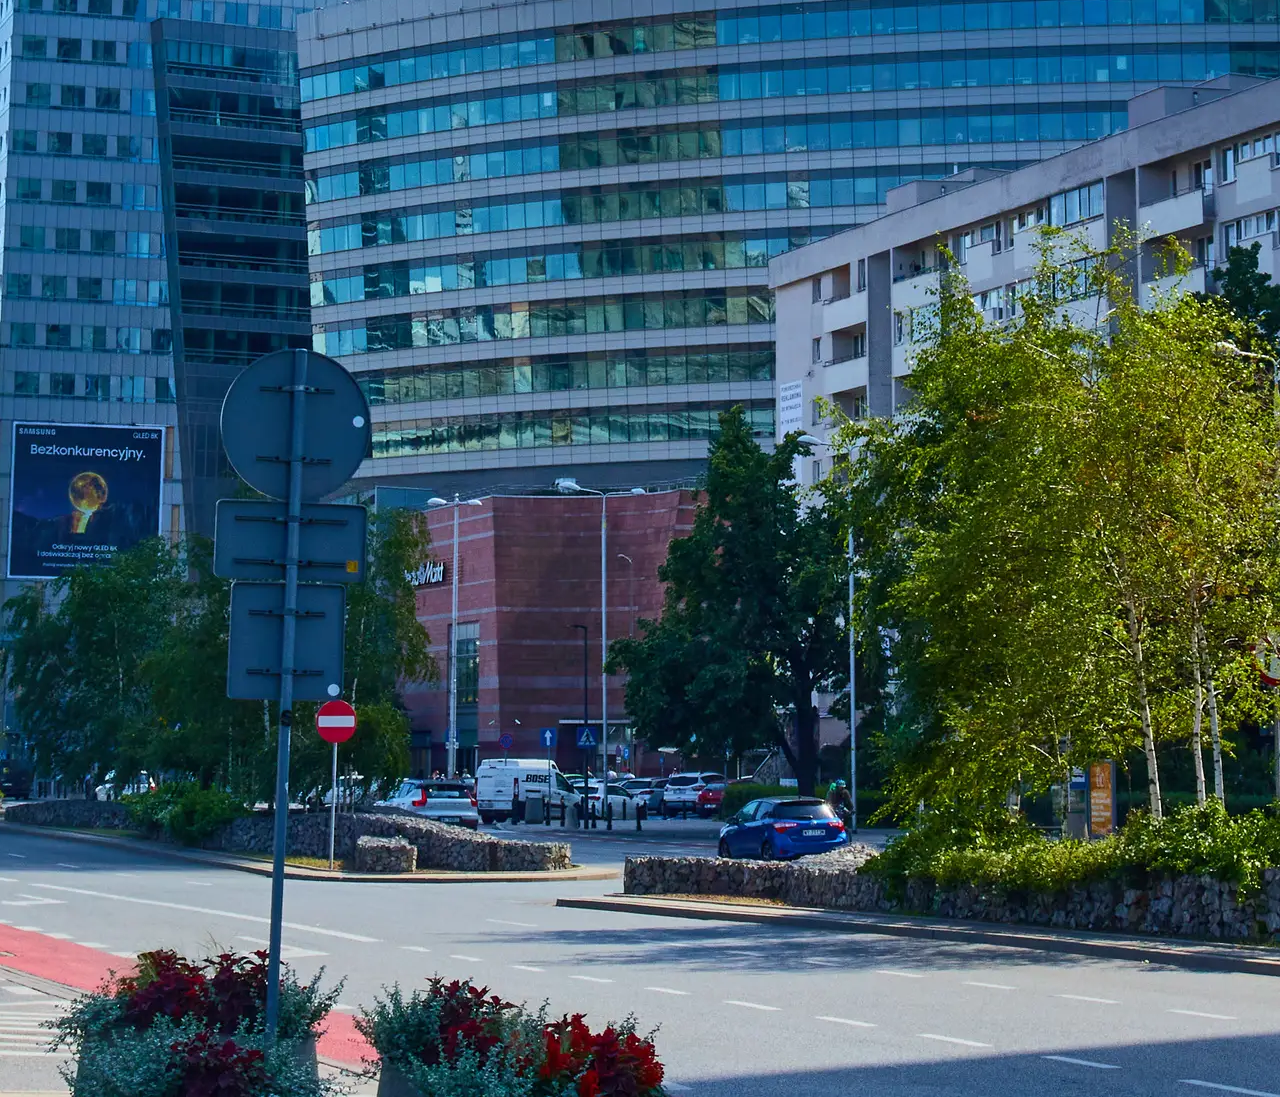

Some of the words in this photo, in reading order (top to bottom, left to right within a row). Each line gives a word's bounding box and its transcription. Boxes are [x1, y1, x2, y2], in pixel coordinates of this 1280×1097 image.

[18, 427, 56, 436] SAMSUNG
[132, 431, 150, 439] QLED
[30, 443, 146, 461] Bezkonkurencyjny.
